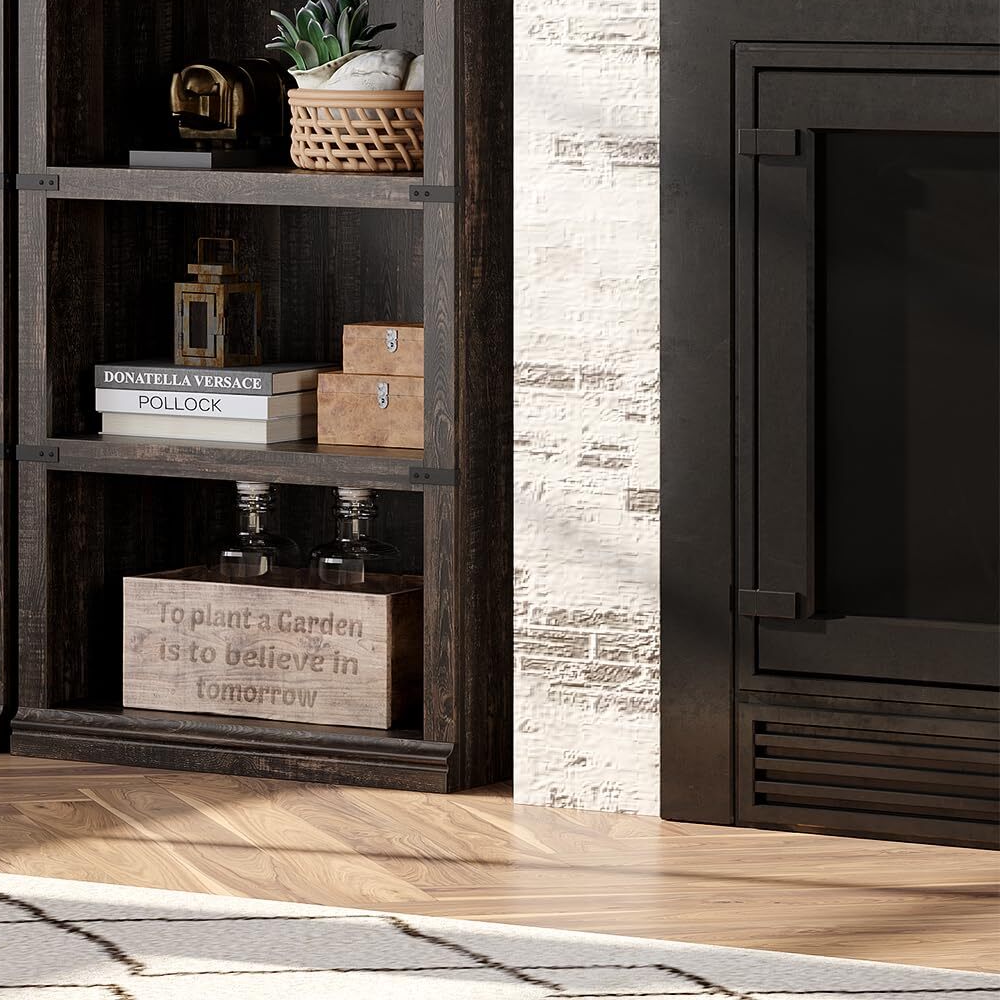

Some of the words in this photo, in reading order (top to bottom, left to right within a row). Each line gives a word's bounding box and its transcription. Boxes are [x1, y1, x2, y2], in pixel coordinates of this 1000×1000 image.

[104, 370, 192, 387] DONATELLA
[193, 375, 262, 390] VERSACE
[138, 395, 222, 412] POLLOCK
[157, 601, 185, 624] To
[190, 603, 251, 632] plant
[257, 614, 272, 630] a
[277, 608, 364, 638] Garden
[159, 638, 180, 662] is
[189, 640, 217, 664] to
[225, 642, 324, 672] believe
[332, 651, 360, 676] in
[196, 677, 318, 708] tomorrow
